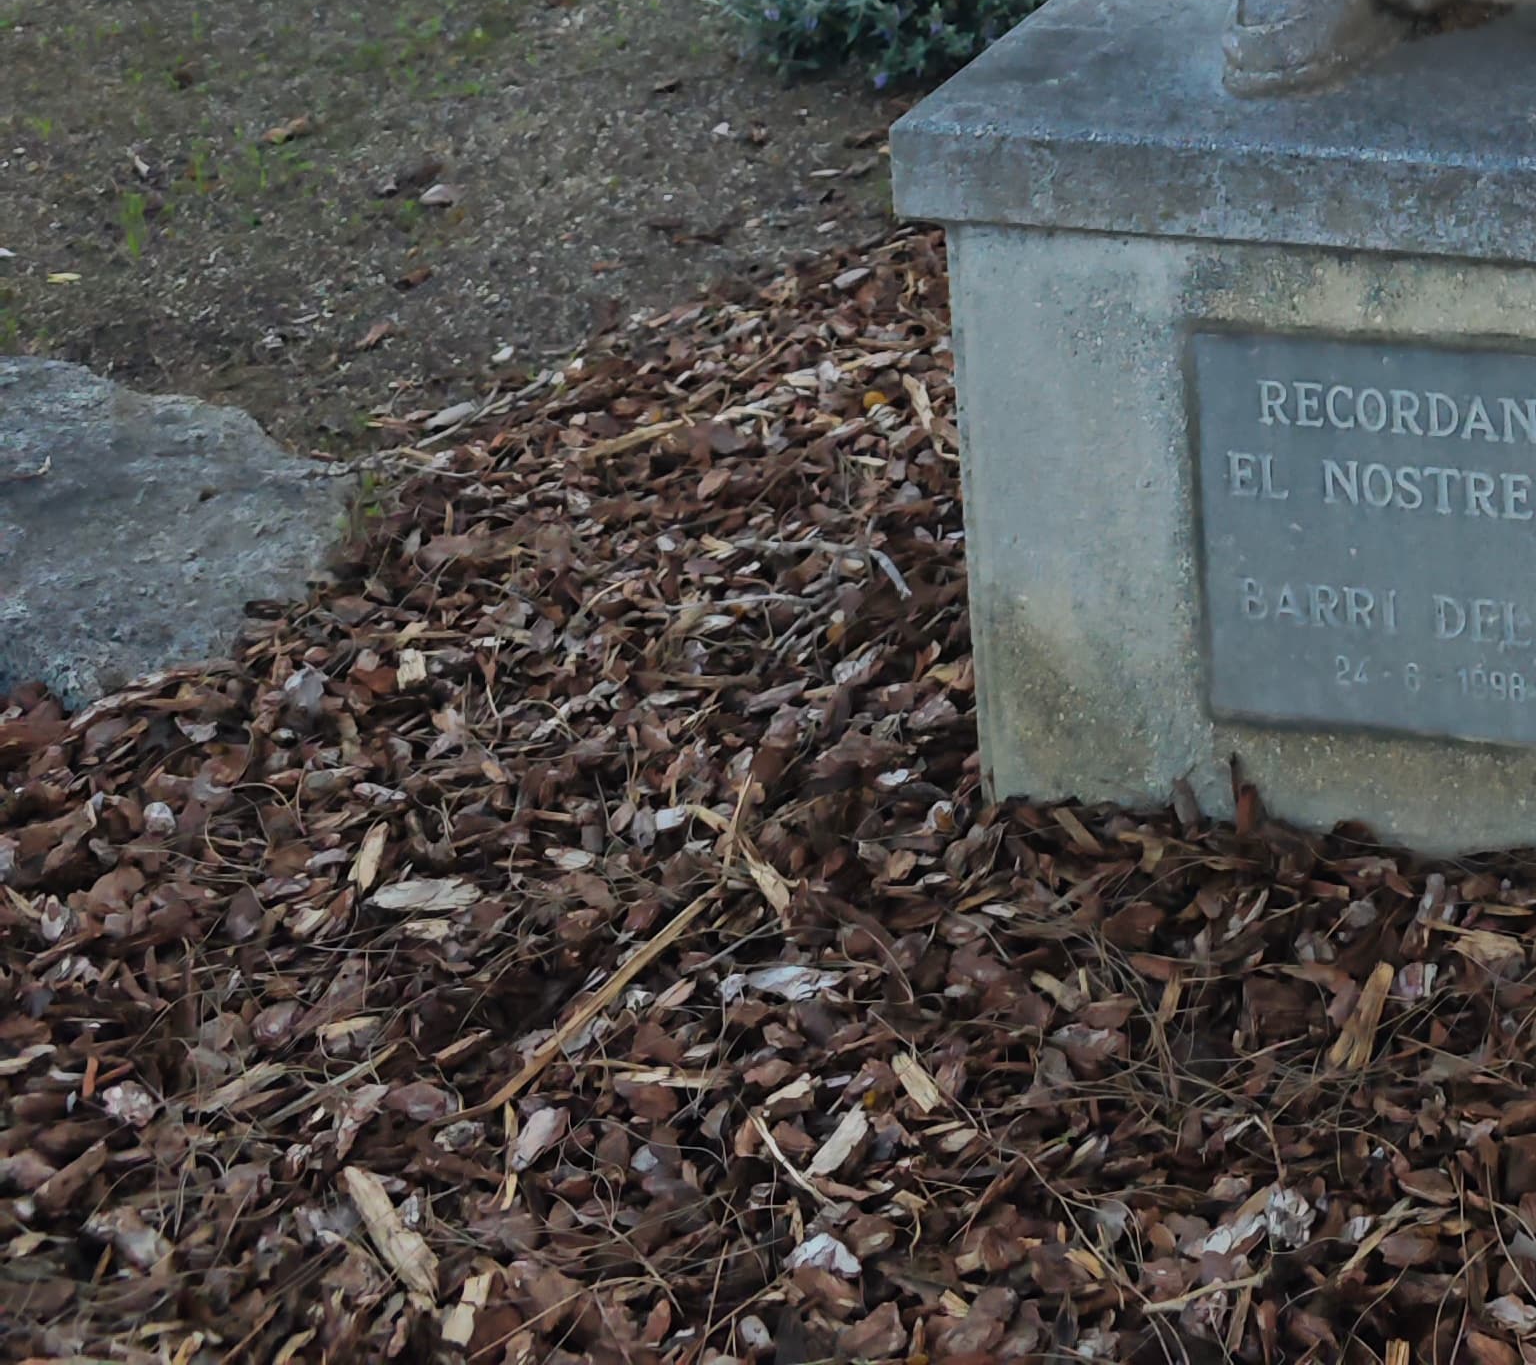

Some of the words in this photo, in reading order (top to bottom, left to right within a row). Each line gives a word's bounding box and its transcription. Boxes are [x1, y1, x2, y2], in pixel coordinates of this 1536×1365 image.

[1226, 449, 1289, 501] EL
[1321, 458, 1534, 521] NOSTRE
[1239, 577, 1398, 636] BARRI
[1432, 593, 1532, 648] DEL
